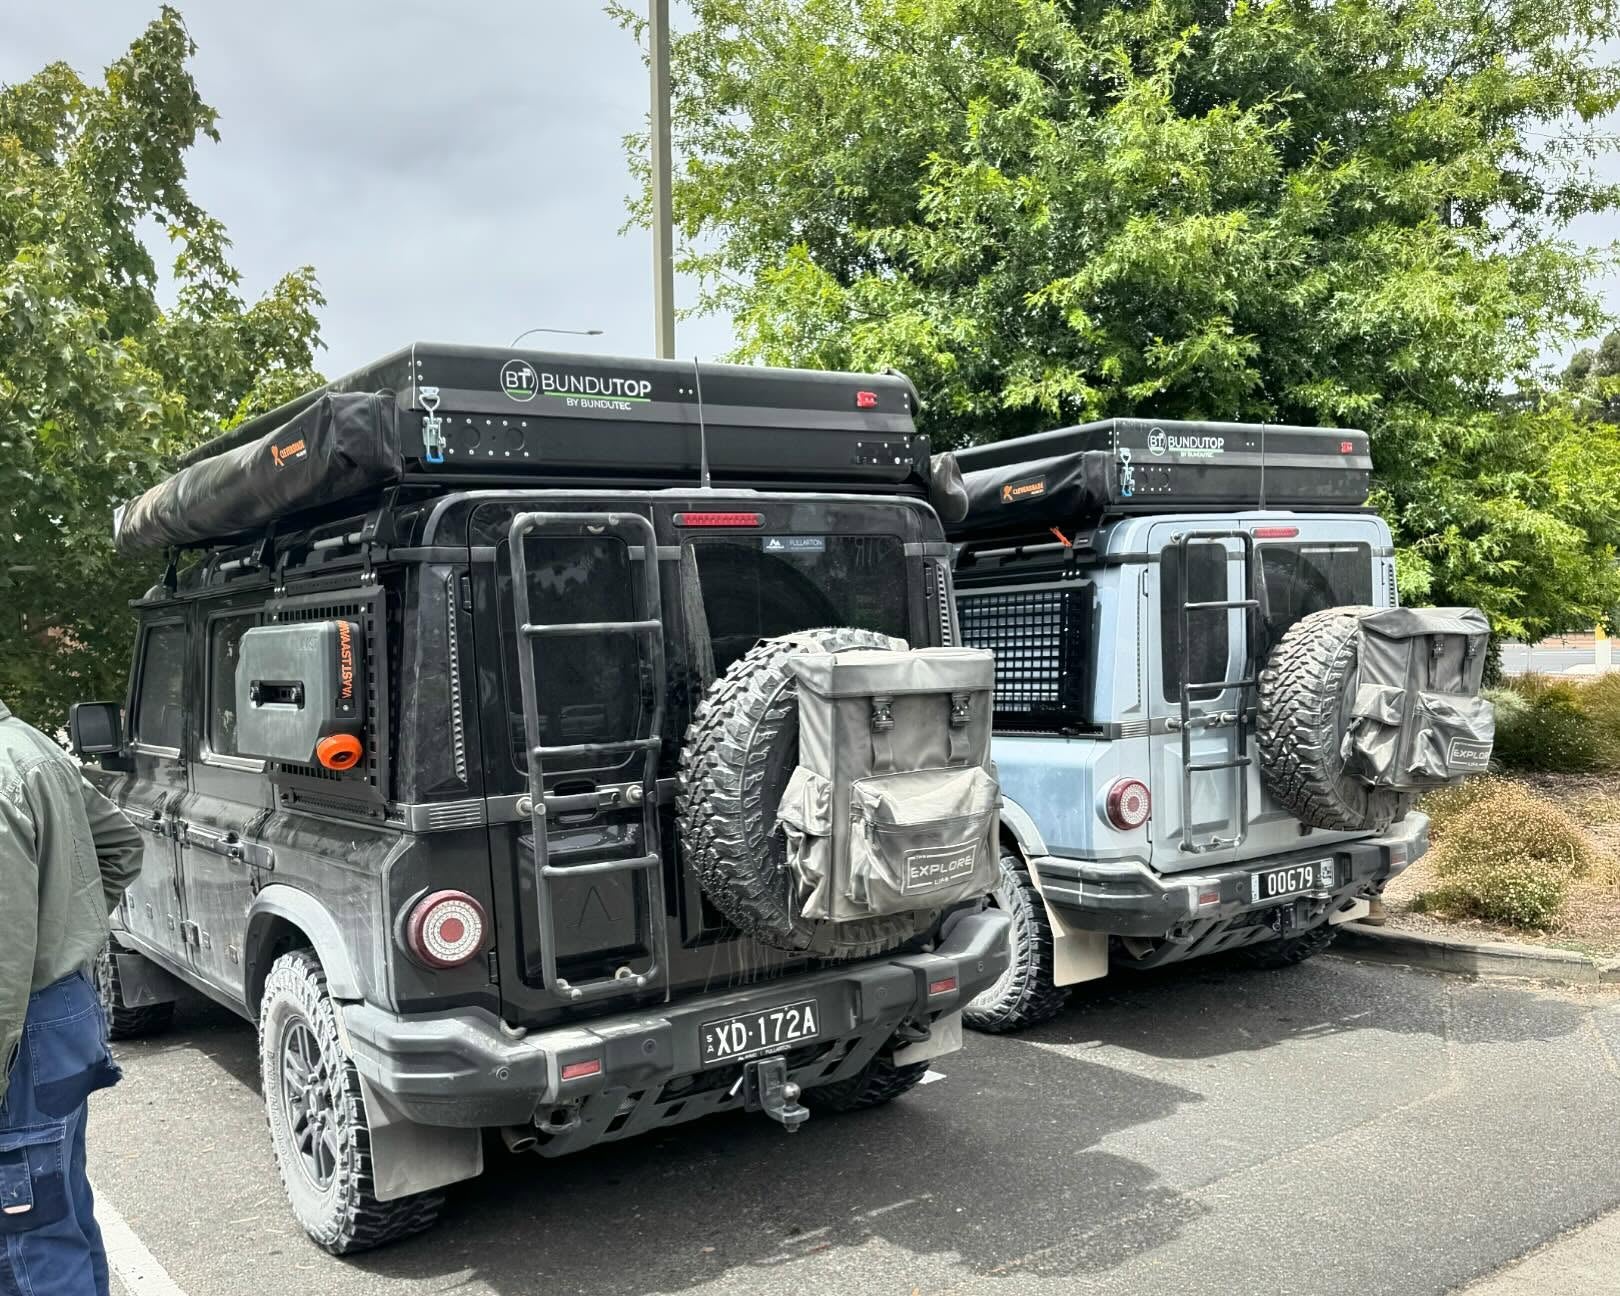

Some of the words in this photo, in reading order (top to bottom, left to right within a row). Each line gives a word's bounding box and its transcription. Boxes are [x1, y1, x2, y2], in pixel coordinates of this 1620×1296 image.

[541, 373, 652, 397] BUNDUTOP
[566, 397, 579, 407] BY
[580, 398, 632, 410] BUNDUTEC
[1168, 435, 1225, 449] BUNDUTOP
[910, 855, 972, 878] EXPLORE
